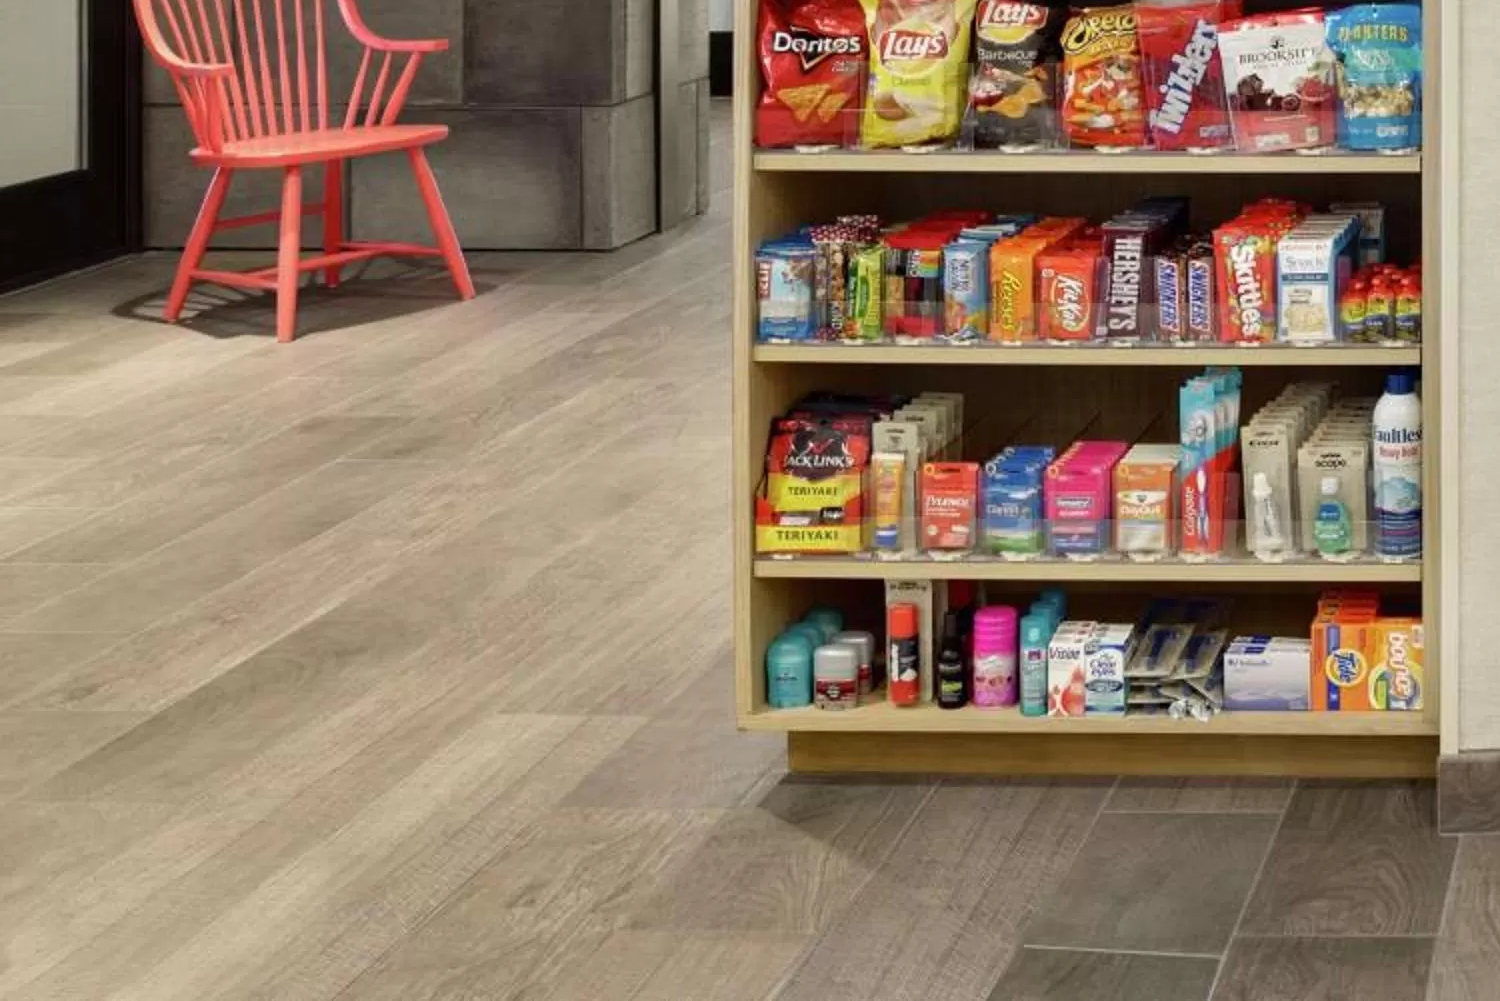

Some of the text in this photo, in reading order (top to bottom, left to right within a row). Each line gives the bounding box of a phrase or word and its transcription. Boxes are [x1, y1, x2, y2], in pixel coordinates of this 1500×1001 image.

[772, 31, 862, 55] Doritos
[1061, 13, 1138, 56] Cheeto
[1338, 24, 1409, 42] PLANTERS
[1109, 237, 1143, 331] HERSHEY'S
[1158, 261, 1180, 332] SNICKERS
[1190, 260, 1210, 330] SNICKERS
[1231, 244, 1264, 337] Skittles
[788, 485, 839, 497] TERIYAKI
[775, 530, 840, 542] TERIYAKI
[1334, 651, 1358, 683] Tide
[1388, 631, 1412, 697] bounce
